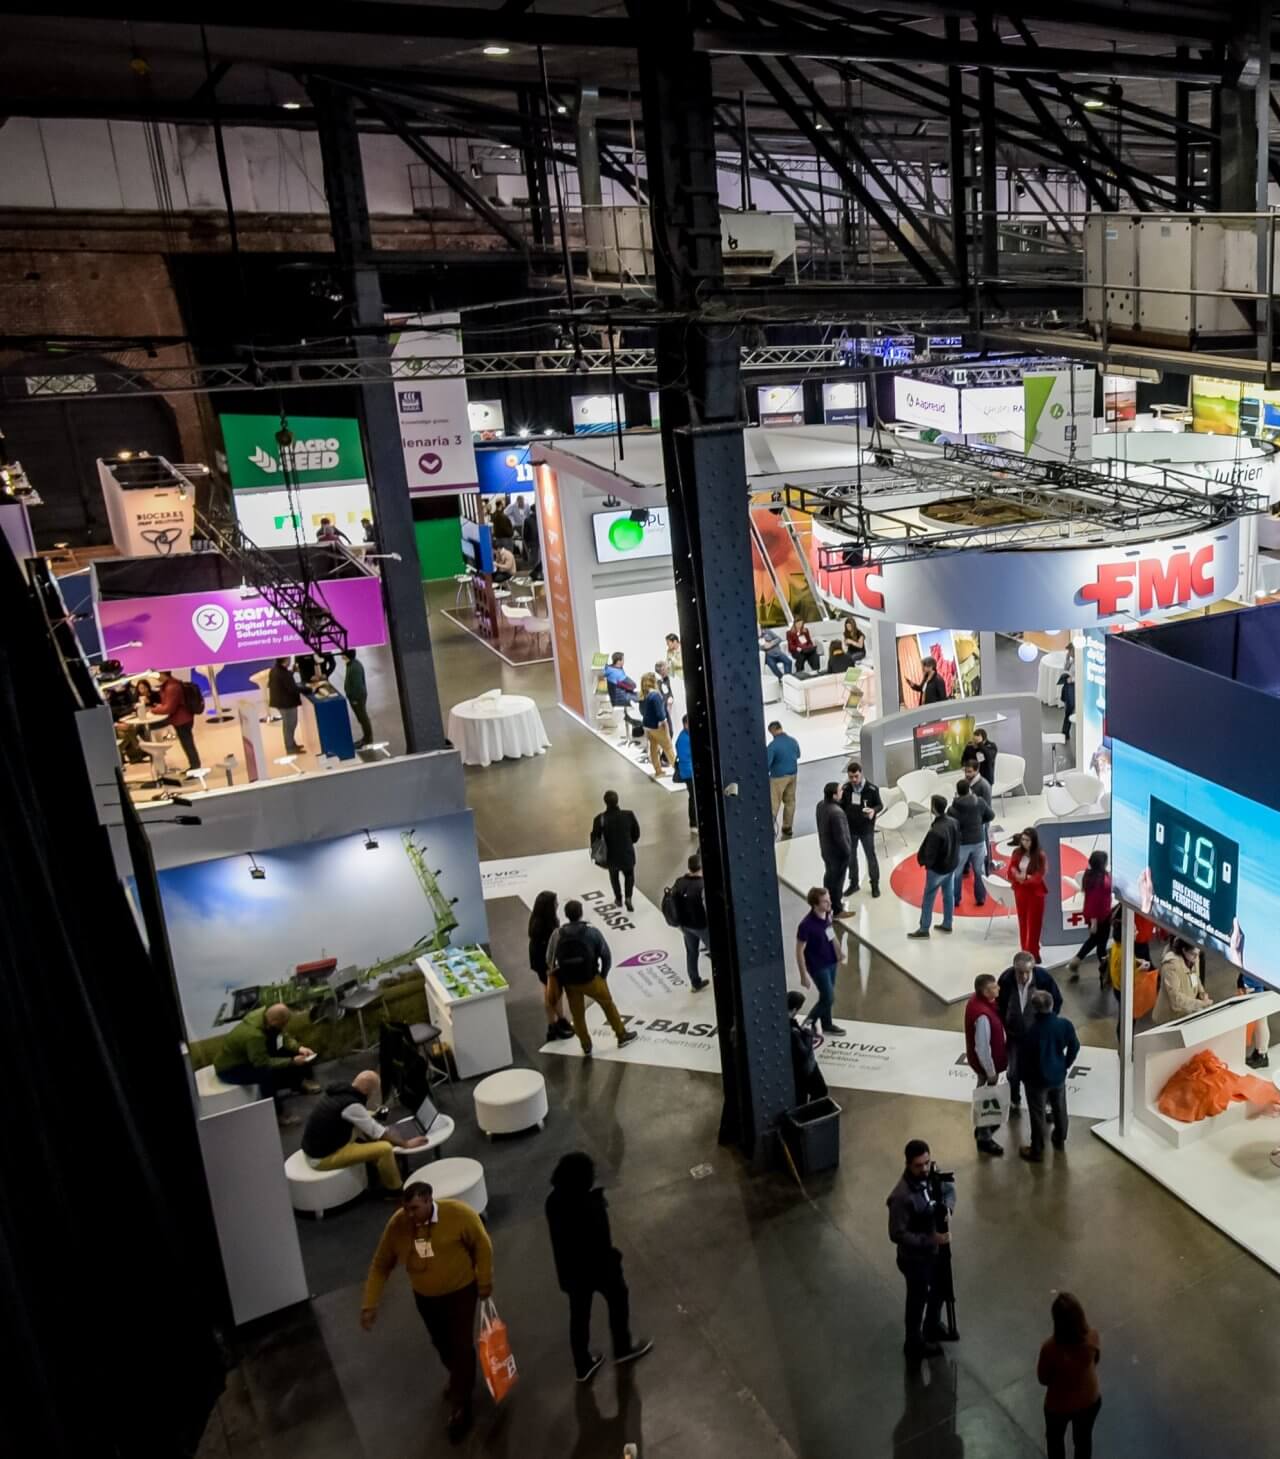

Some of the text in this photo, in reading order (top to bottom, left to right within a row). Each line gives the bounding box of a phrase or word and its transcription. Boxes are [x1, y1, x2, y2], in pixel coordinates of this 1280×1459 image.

[915, 398, 946, 414] Aapresid
[402, 435, 463, 449] lenaria 3
[1081, 544, 1215, 617] FMC
[234, 619, 265, 632] Digital
[236, 628, 278, 640] Solutions
[594, 903, 637, 932] BASF
[828, 1039, 888, 1054] xarvio
